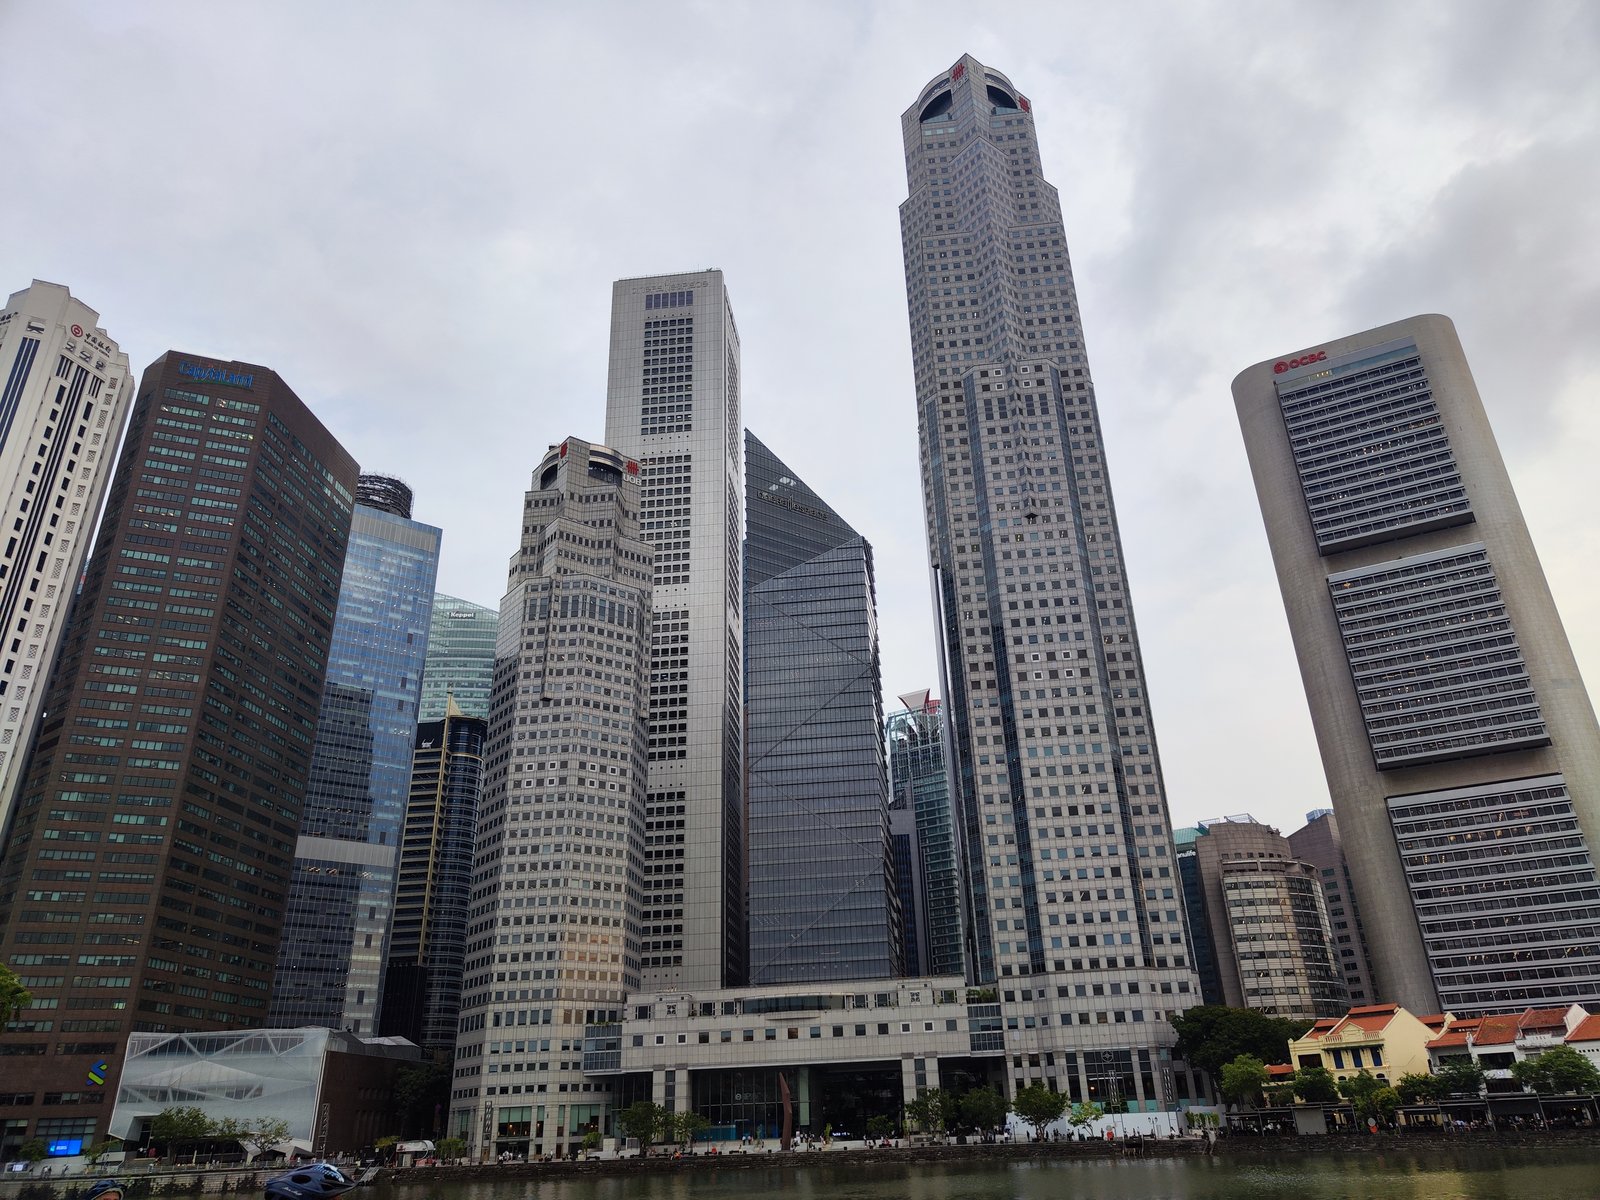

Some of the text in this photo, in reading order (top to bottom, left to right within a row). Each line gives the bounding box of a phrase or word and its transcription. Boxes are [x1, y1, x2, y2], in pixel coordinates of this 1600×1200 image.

[1289, 350, 1327, 369] OCBC
[178, 360, 254, 388] CapitaLand
[623, 472, 642, 486] UOB
[450, 610, 474, 618] Keppel
